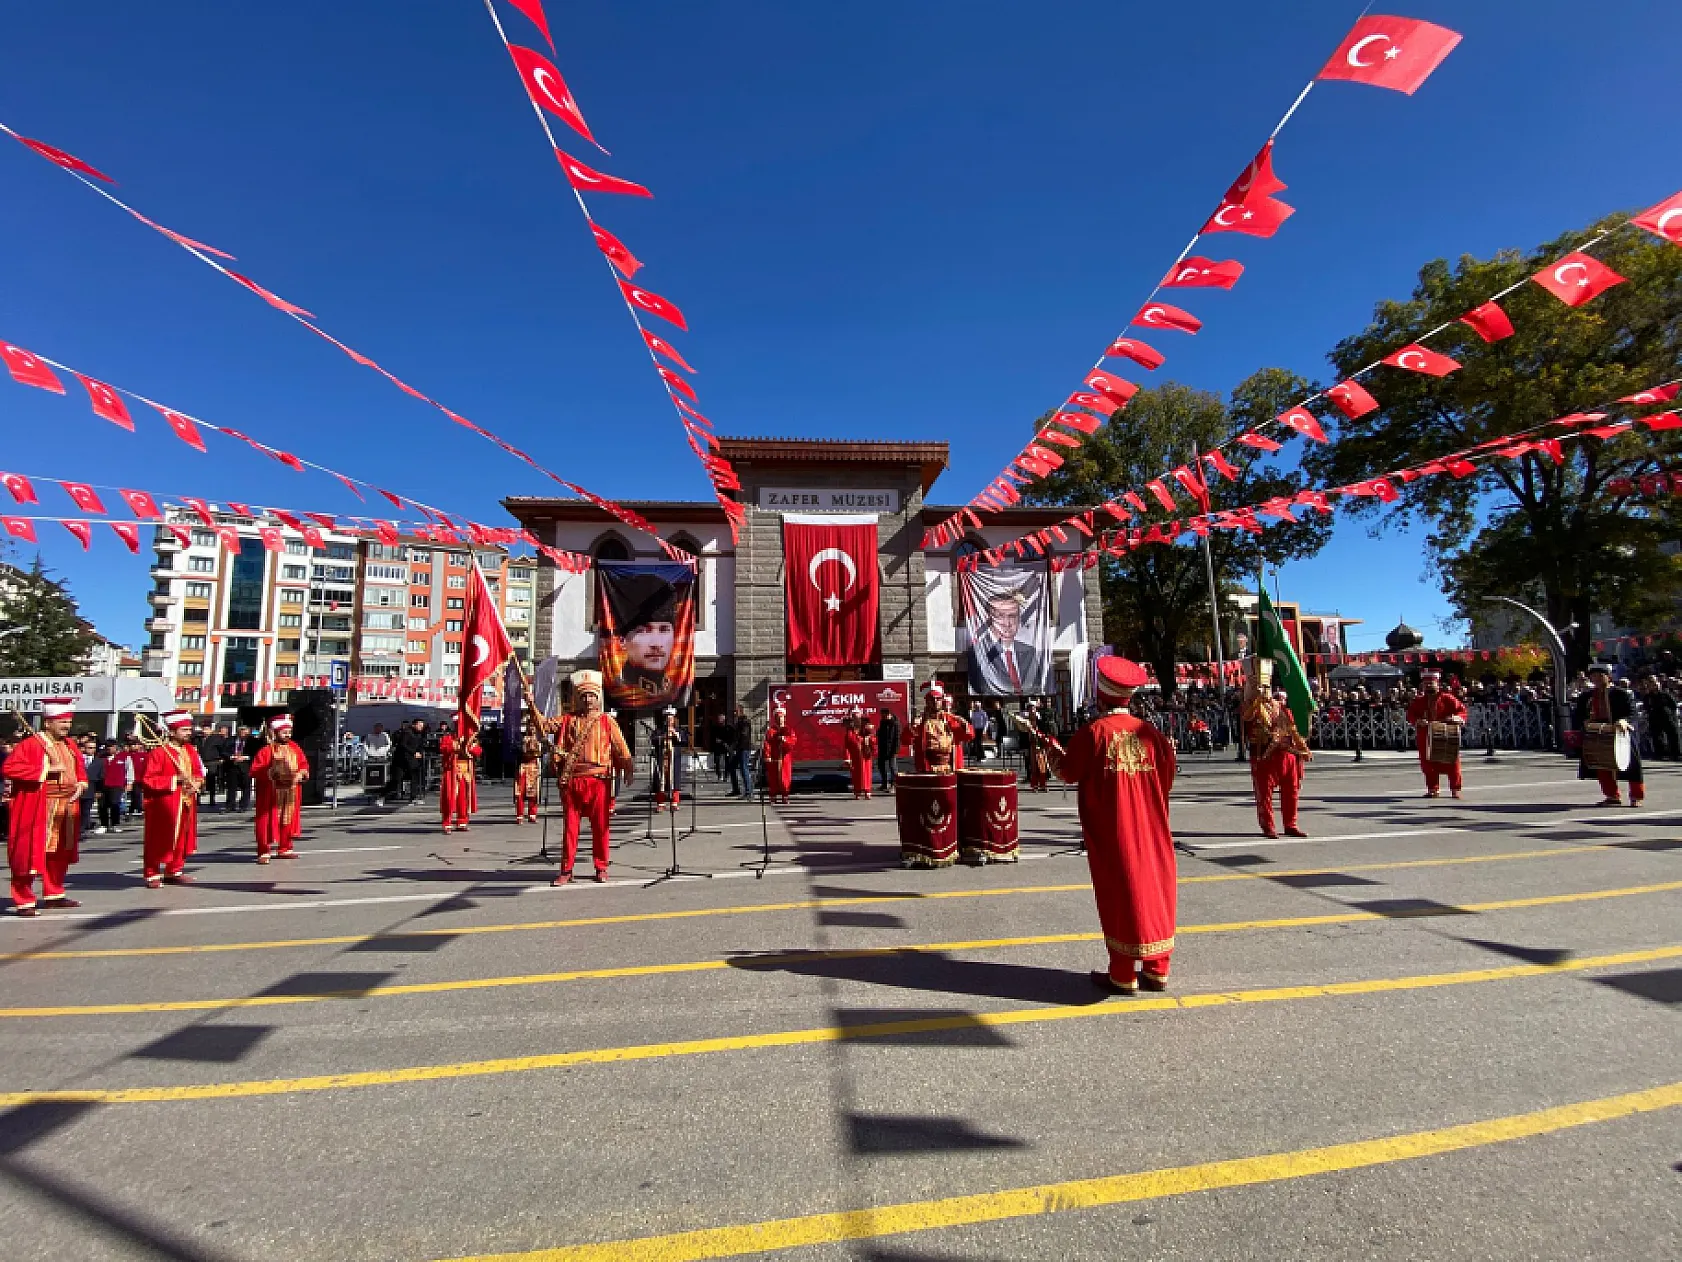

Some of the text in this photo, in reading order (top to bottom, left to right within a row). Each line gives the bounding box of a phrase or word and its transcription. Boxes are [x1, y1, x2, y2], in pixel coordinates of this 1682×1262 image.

[768, 493, 890, 507] ZAFER MÜZESİ
[831, 693, 865, 705] EKİM
